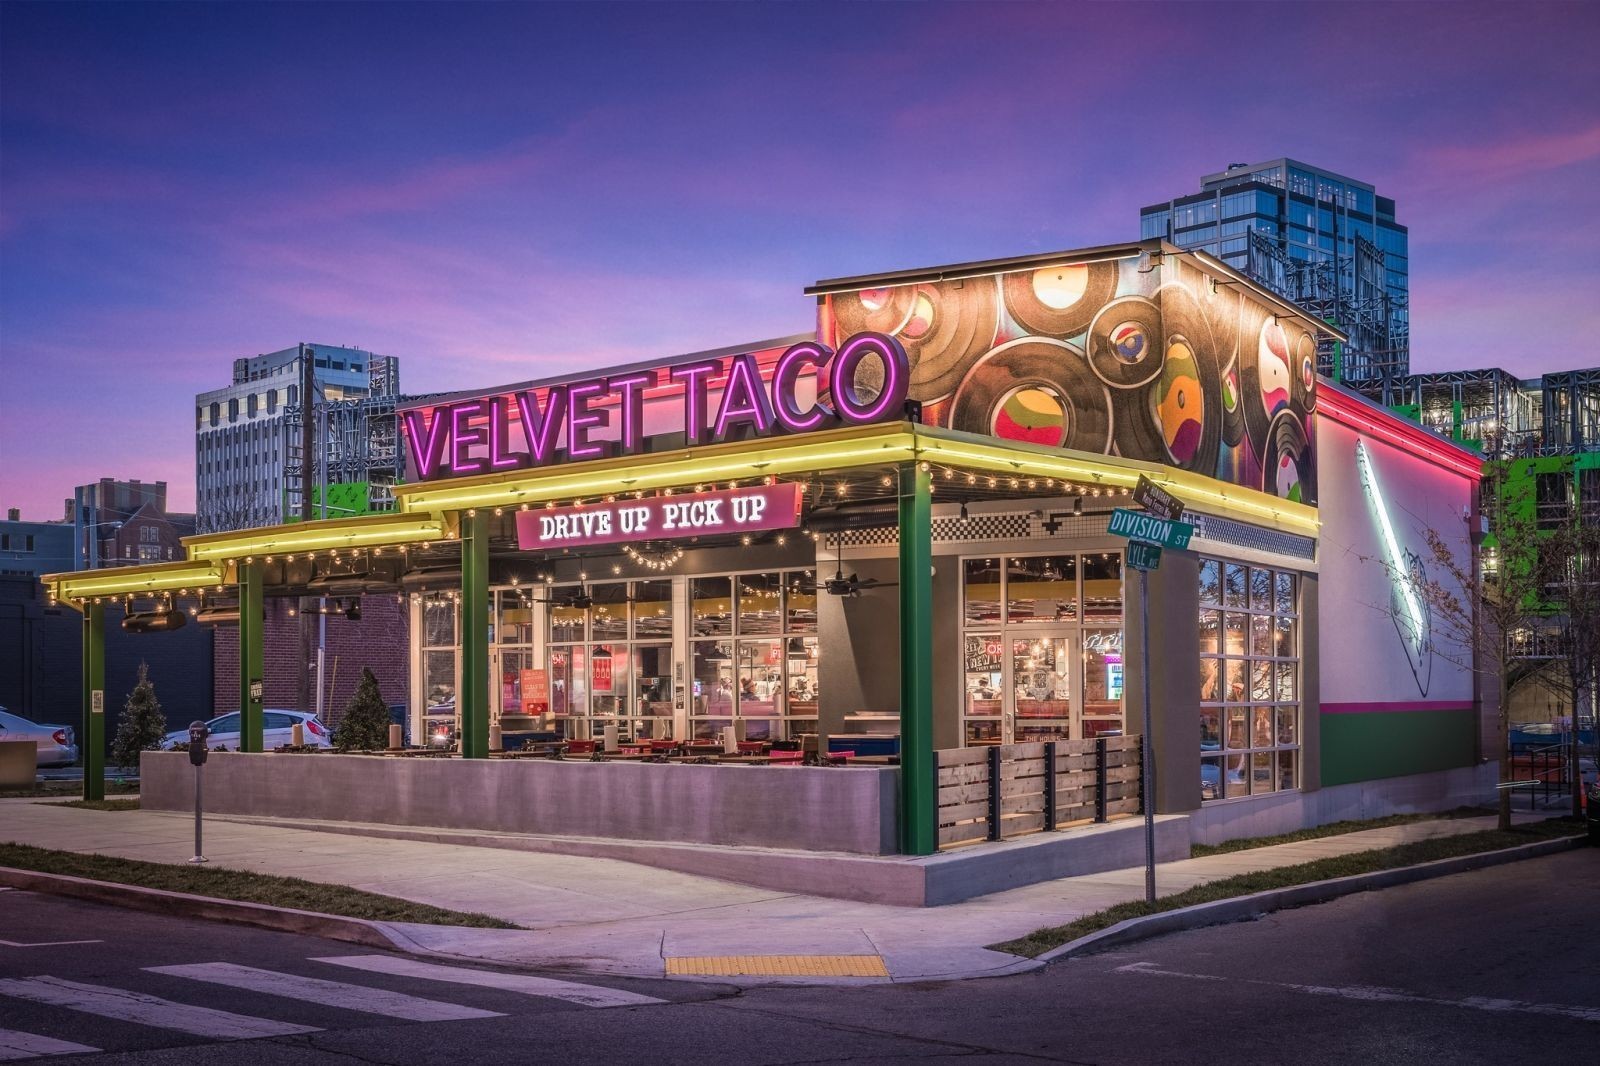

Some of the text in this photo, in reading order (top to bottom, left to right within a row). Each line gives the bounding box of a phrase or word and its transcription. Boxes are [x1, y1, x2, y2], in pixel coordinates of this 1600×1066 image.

[404, 331, 910, 481] VELVET TACO
[539, 495, 767, 540] DRIVE UP PICK UP
[1110, 511, 1173, 542] DIVISION
[1174, 535, 1188, 546] ST
[1127, 544, 1148, 566] LYLE
